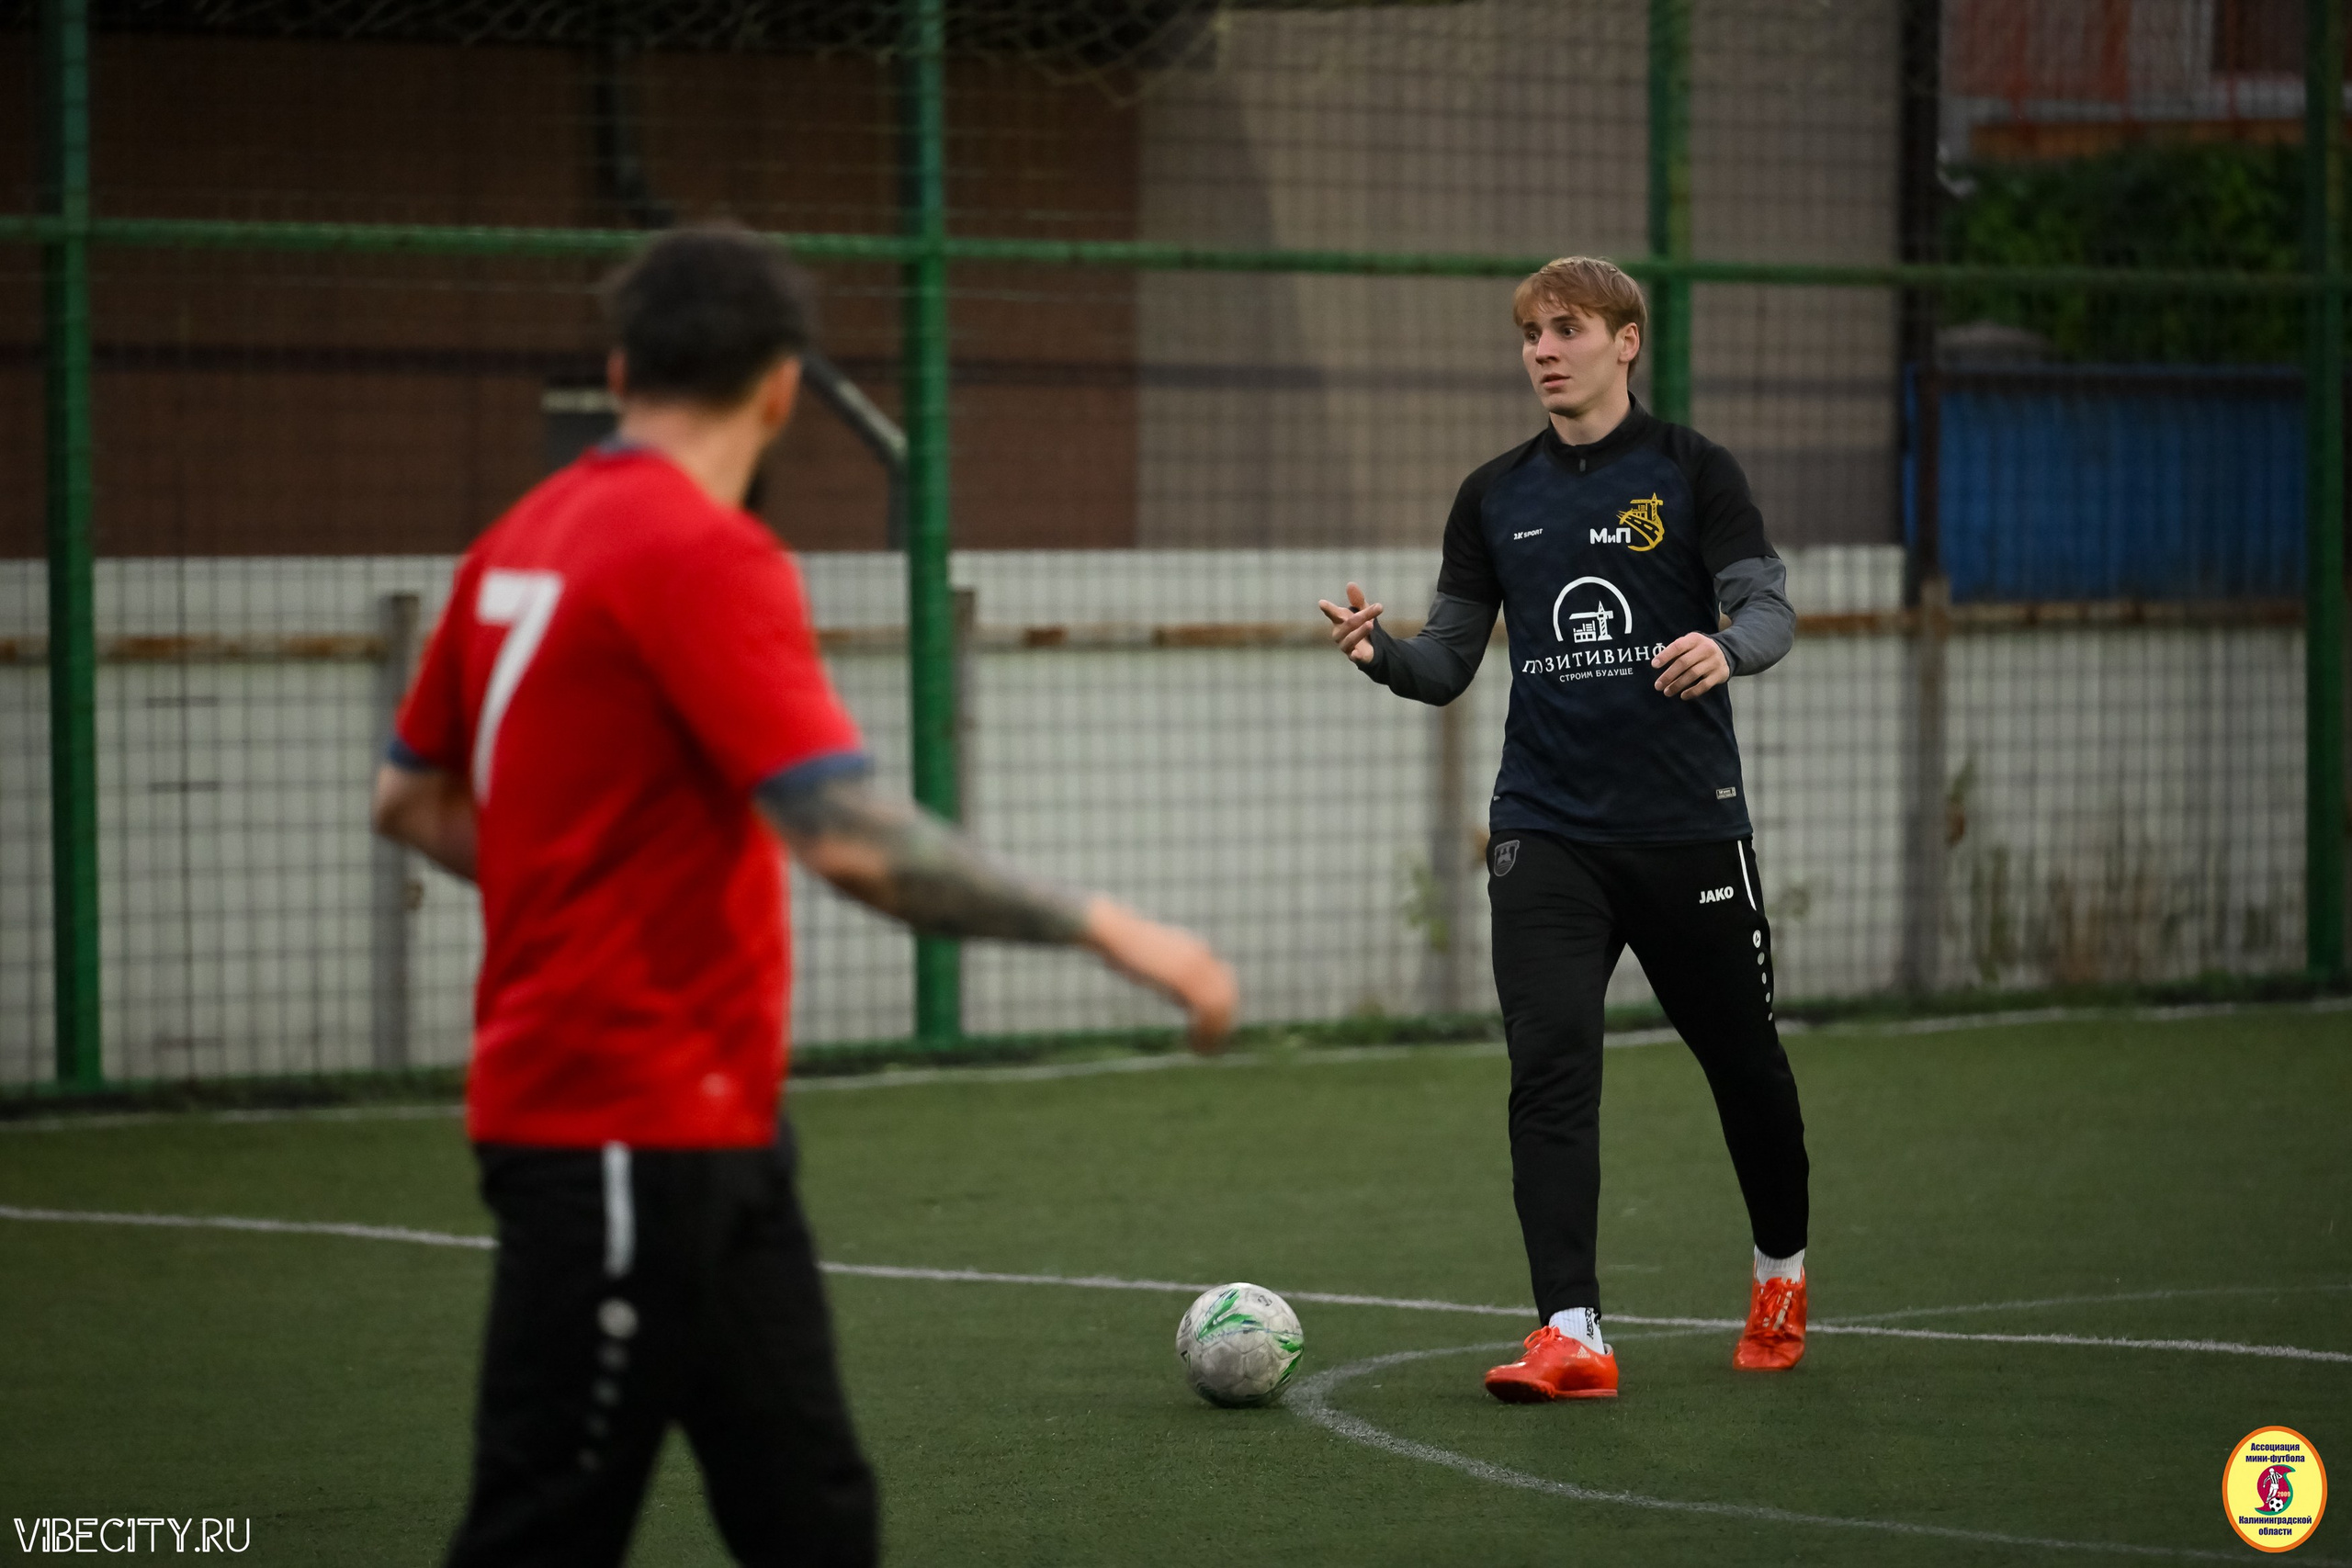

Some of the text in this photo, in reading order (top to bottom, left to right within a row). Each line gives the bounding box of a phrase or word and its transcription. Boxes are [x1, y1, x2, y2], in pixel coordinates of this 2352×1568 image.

[1523, 528, 1544, 538] SPORT
[1589, 527, 1632, 545] МиП
[1559, 671, 1594, 682] СТРОИМ
[473, 568, 563, 805] 7
[1699, 886, 1734, 904] JAKO
